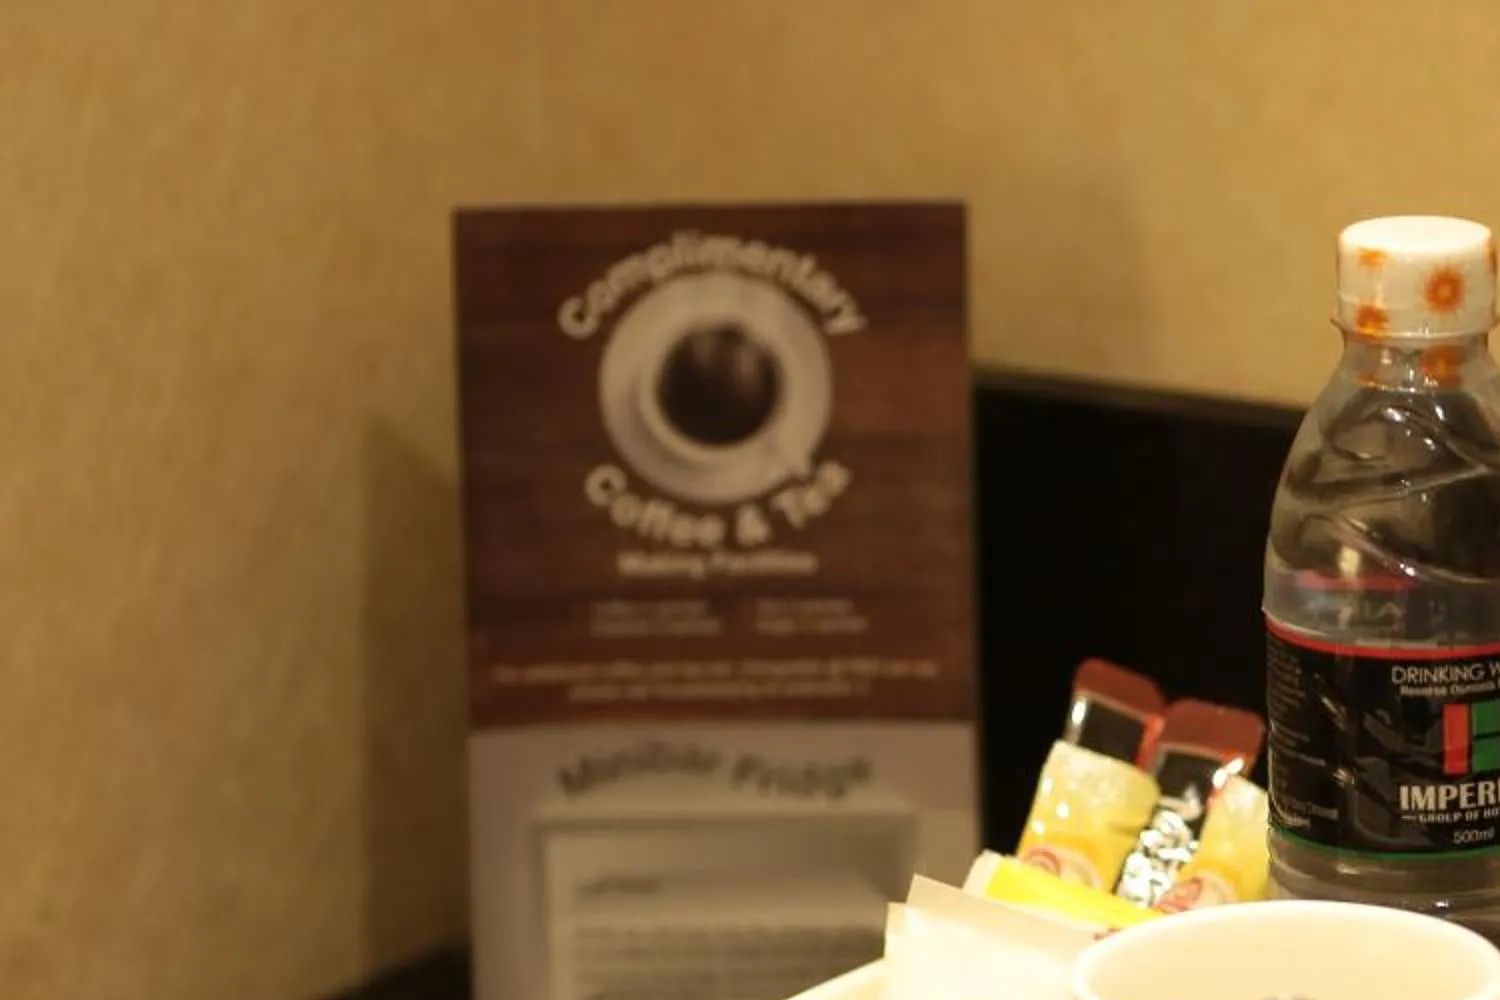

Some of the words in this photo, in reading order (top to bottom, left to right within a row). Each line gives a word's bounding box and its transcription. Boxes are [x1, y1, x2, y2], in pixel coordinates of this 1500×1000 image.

[558, 230, 866, 340] Complimentary
[585, 464, 728, 549] Coffee
[1391, 660, 1485, 686] DRINKING
[1419, 810, 1463, 824] GROUP
[1465, 807, 1479, 822] OF
[1452, 826, 1496, 846] 500ml
